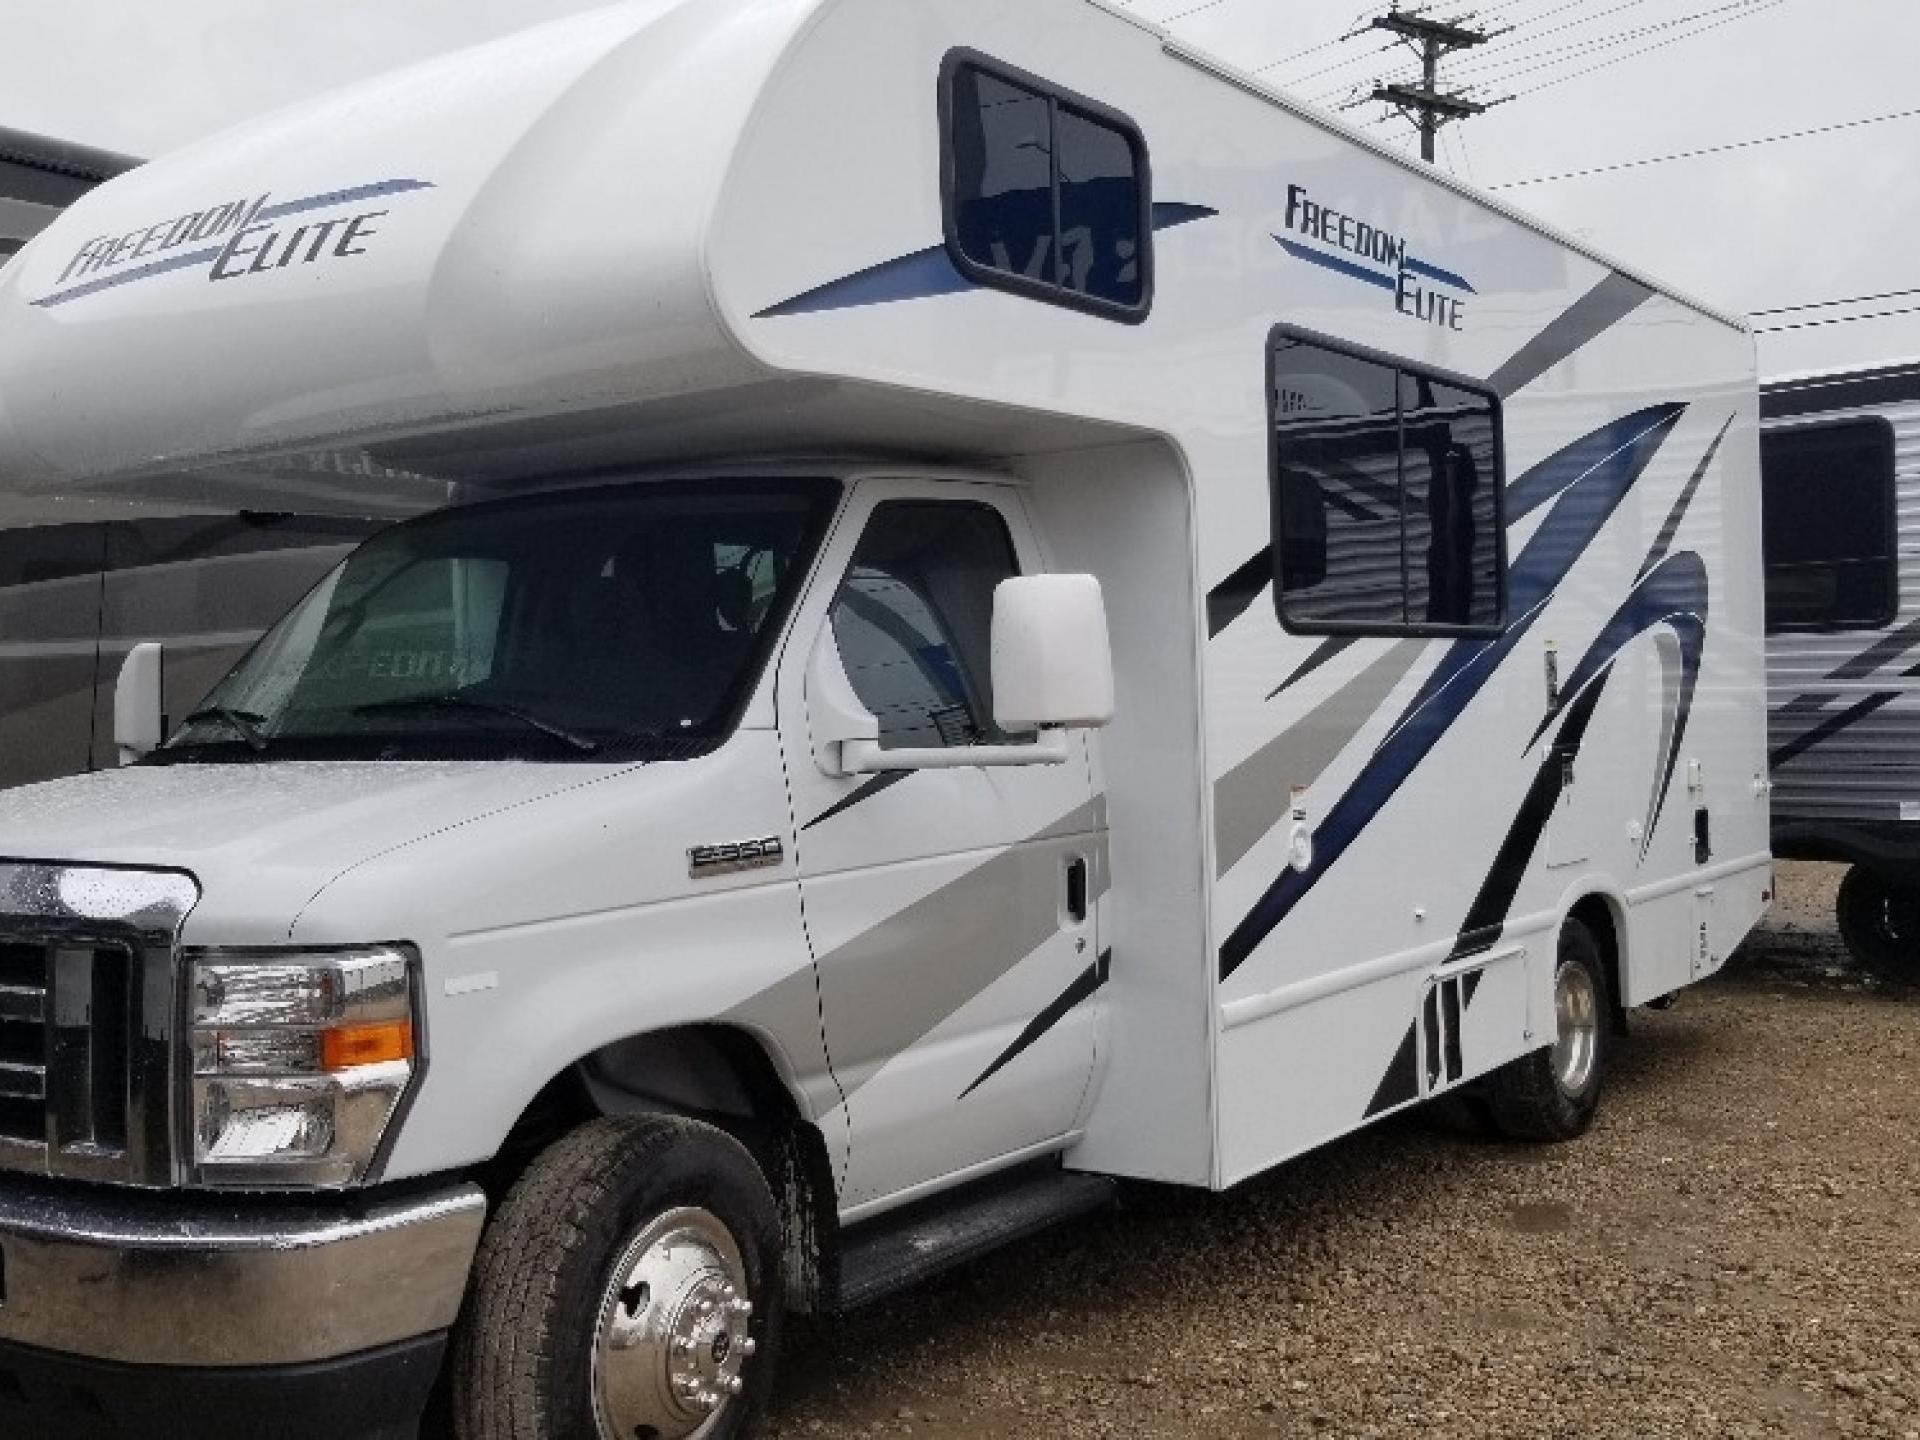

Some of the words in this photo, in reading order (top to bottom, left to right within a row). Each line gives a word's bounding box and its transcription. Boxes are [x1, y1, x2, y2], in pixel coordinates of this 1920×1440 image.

[56, 191, 271, 284] FREEDOM
[209, 209, 389, 281] ELITE
[1285, 184, 1406, 270] FREEDOM
[1395, 271, 1466, 331] ELITE
